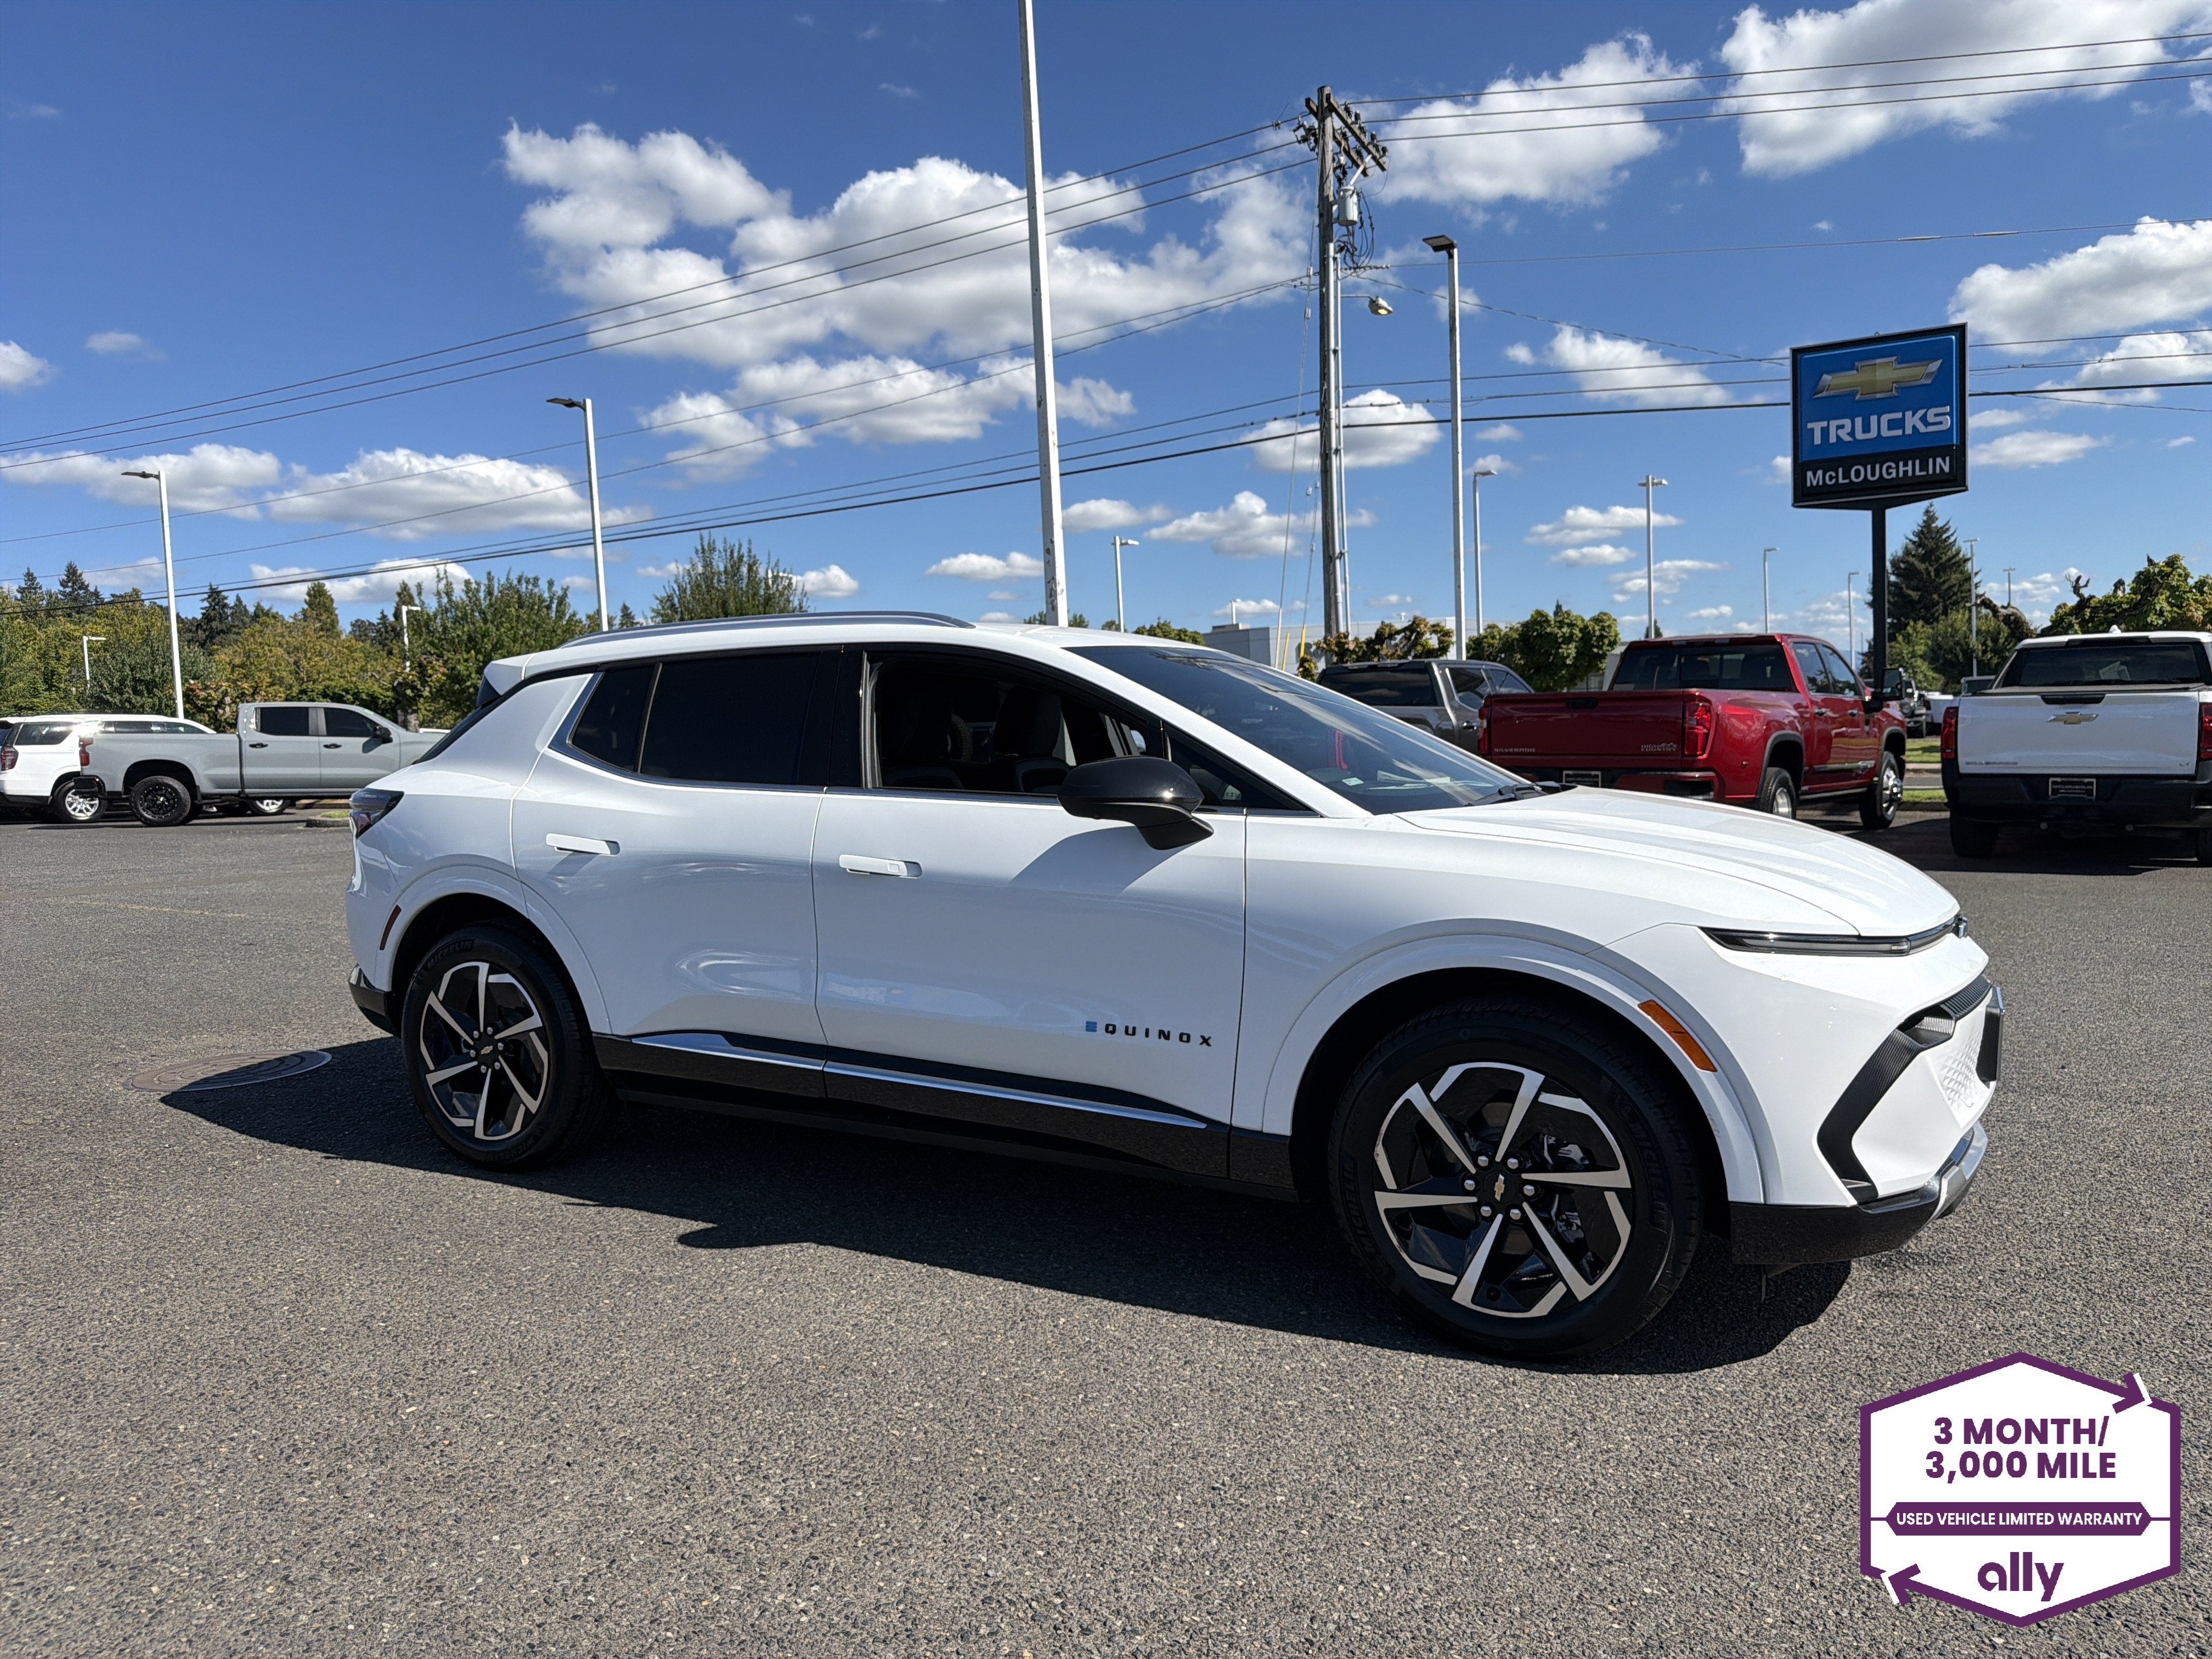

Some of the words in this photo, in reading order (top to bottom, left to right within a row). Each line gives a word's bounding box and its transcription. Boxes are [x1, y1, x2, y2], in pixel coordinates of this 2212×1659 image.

[1807, 405, 1950, 445] TRUCKS
[1806, 456, 1950, 487] McLOUGHLIN
[1085, 1020, 1212, 1047] EQUINOX
